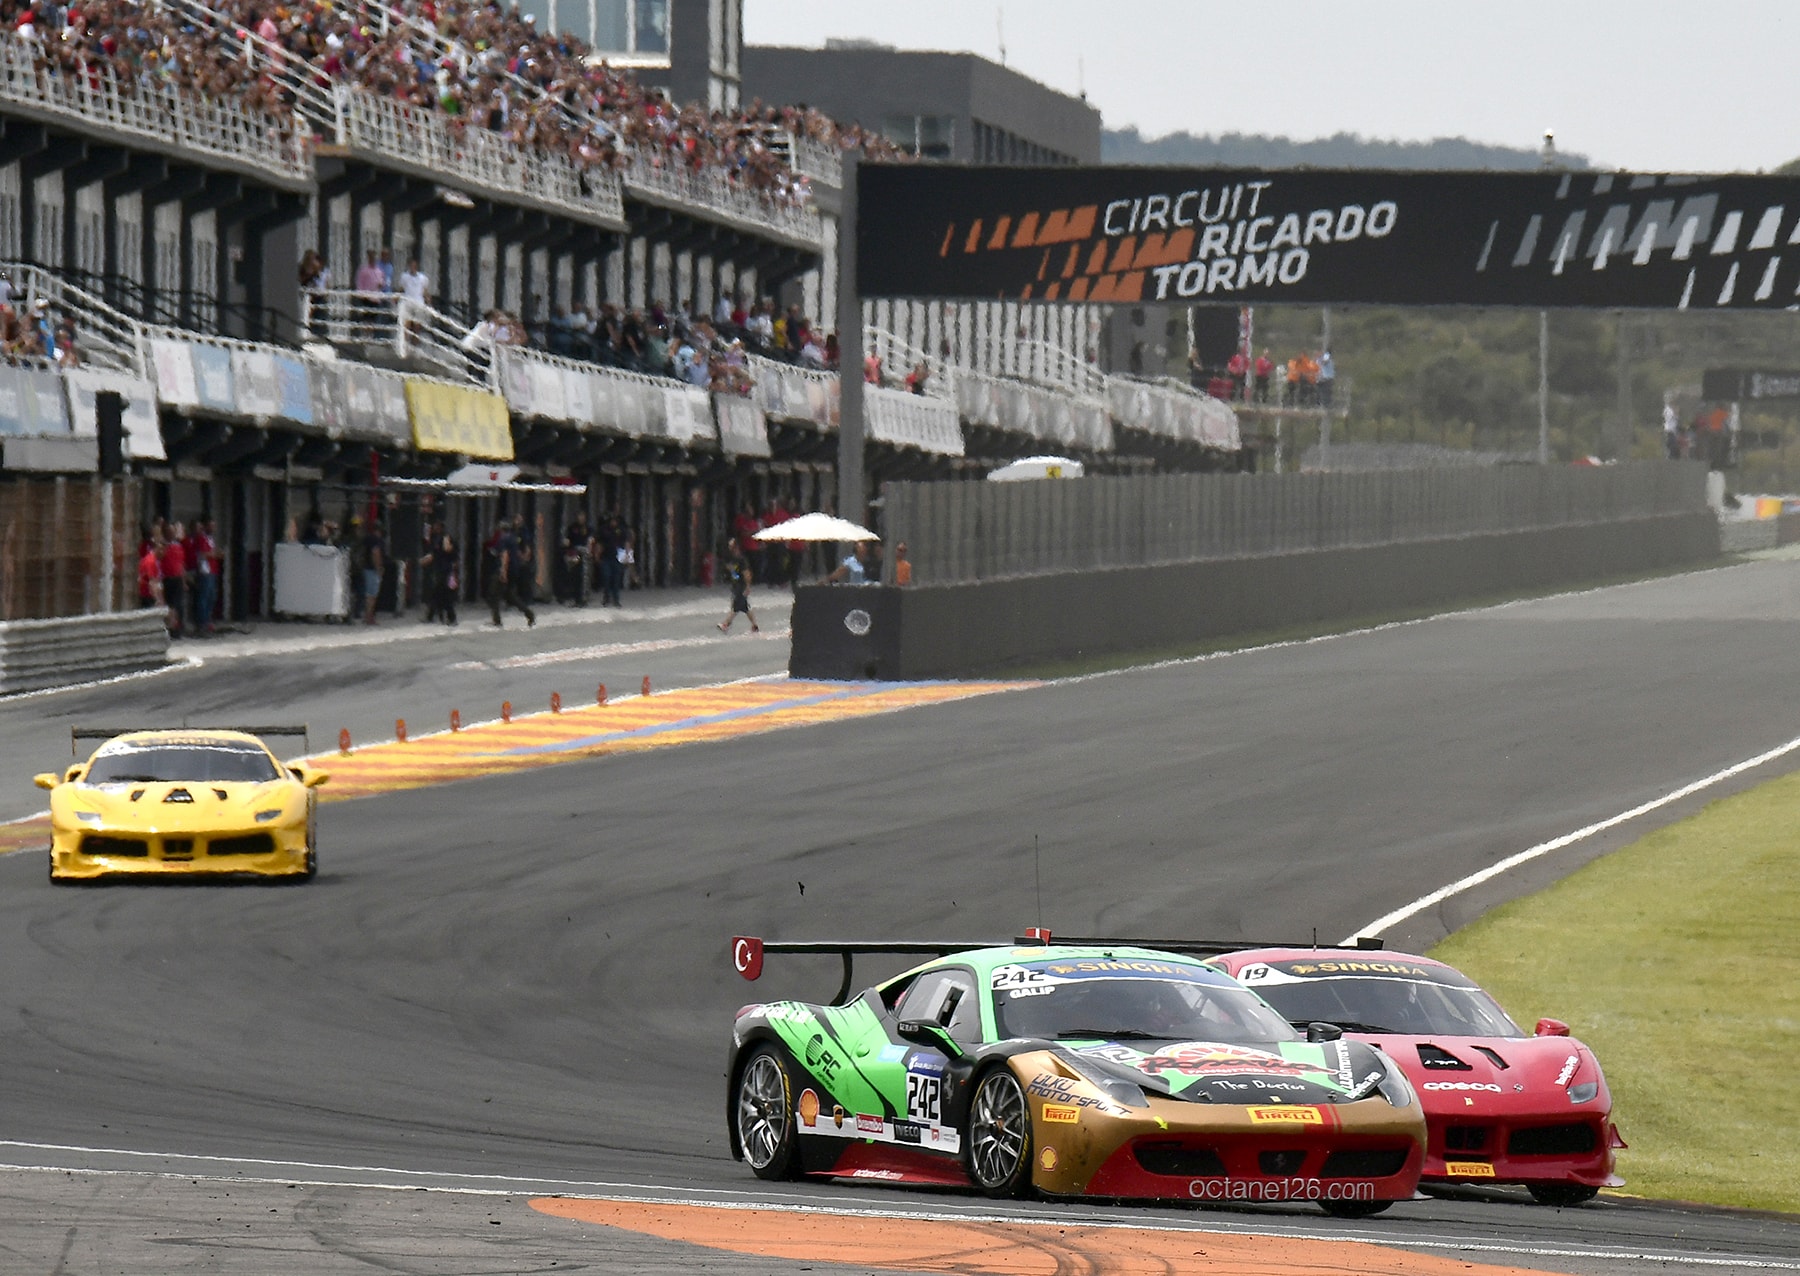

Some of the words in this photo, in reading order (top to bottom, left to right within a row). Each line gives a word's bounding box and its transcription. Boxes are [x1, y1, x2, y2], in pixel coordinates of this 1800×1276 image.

[1103, 180, 1273, 235] CIRCUIT
[1198, 201, 1399, 260] RICARDO
[1152, 249, 1310, 300] TORMO
[1074, 961, 1193, 977] SINGHA
[1244, 967, 1269, 980] 19
[1318, 962, 1429, 977] SINGHA
[992, 969, 1045, 988] 242
[1010, 986, 1056, 999] GALIP
[1211, 1080, 1249, 1093] The
[908, 1075, 939, 1120] 242
[1045, 1108, 1076, 1119] PIRELLI
[1254, 1110, 1314, 1120] PIRELLI
[894, 1123, 920, 1138] IVECO
[1189, 1177, 1375, 1200] octane126.com
